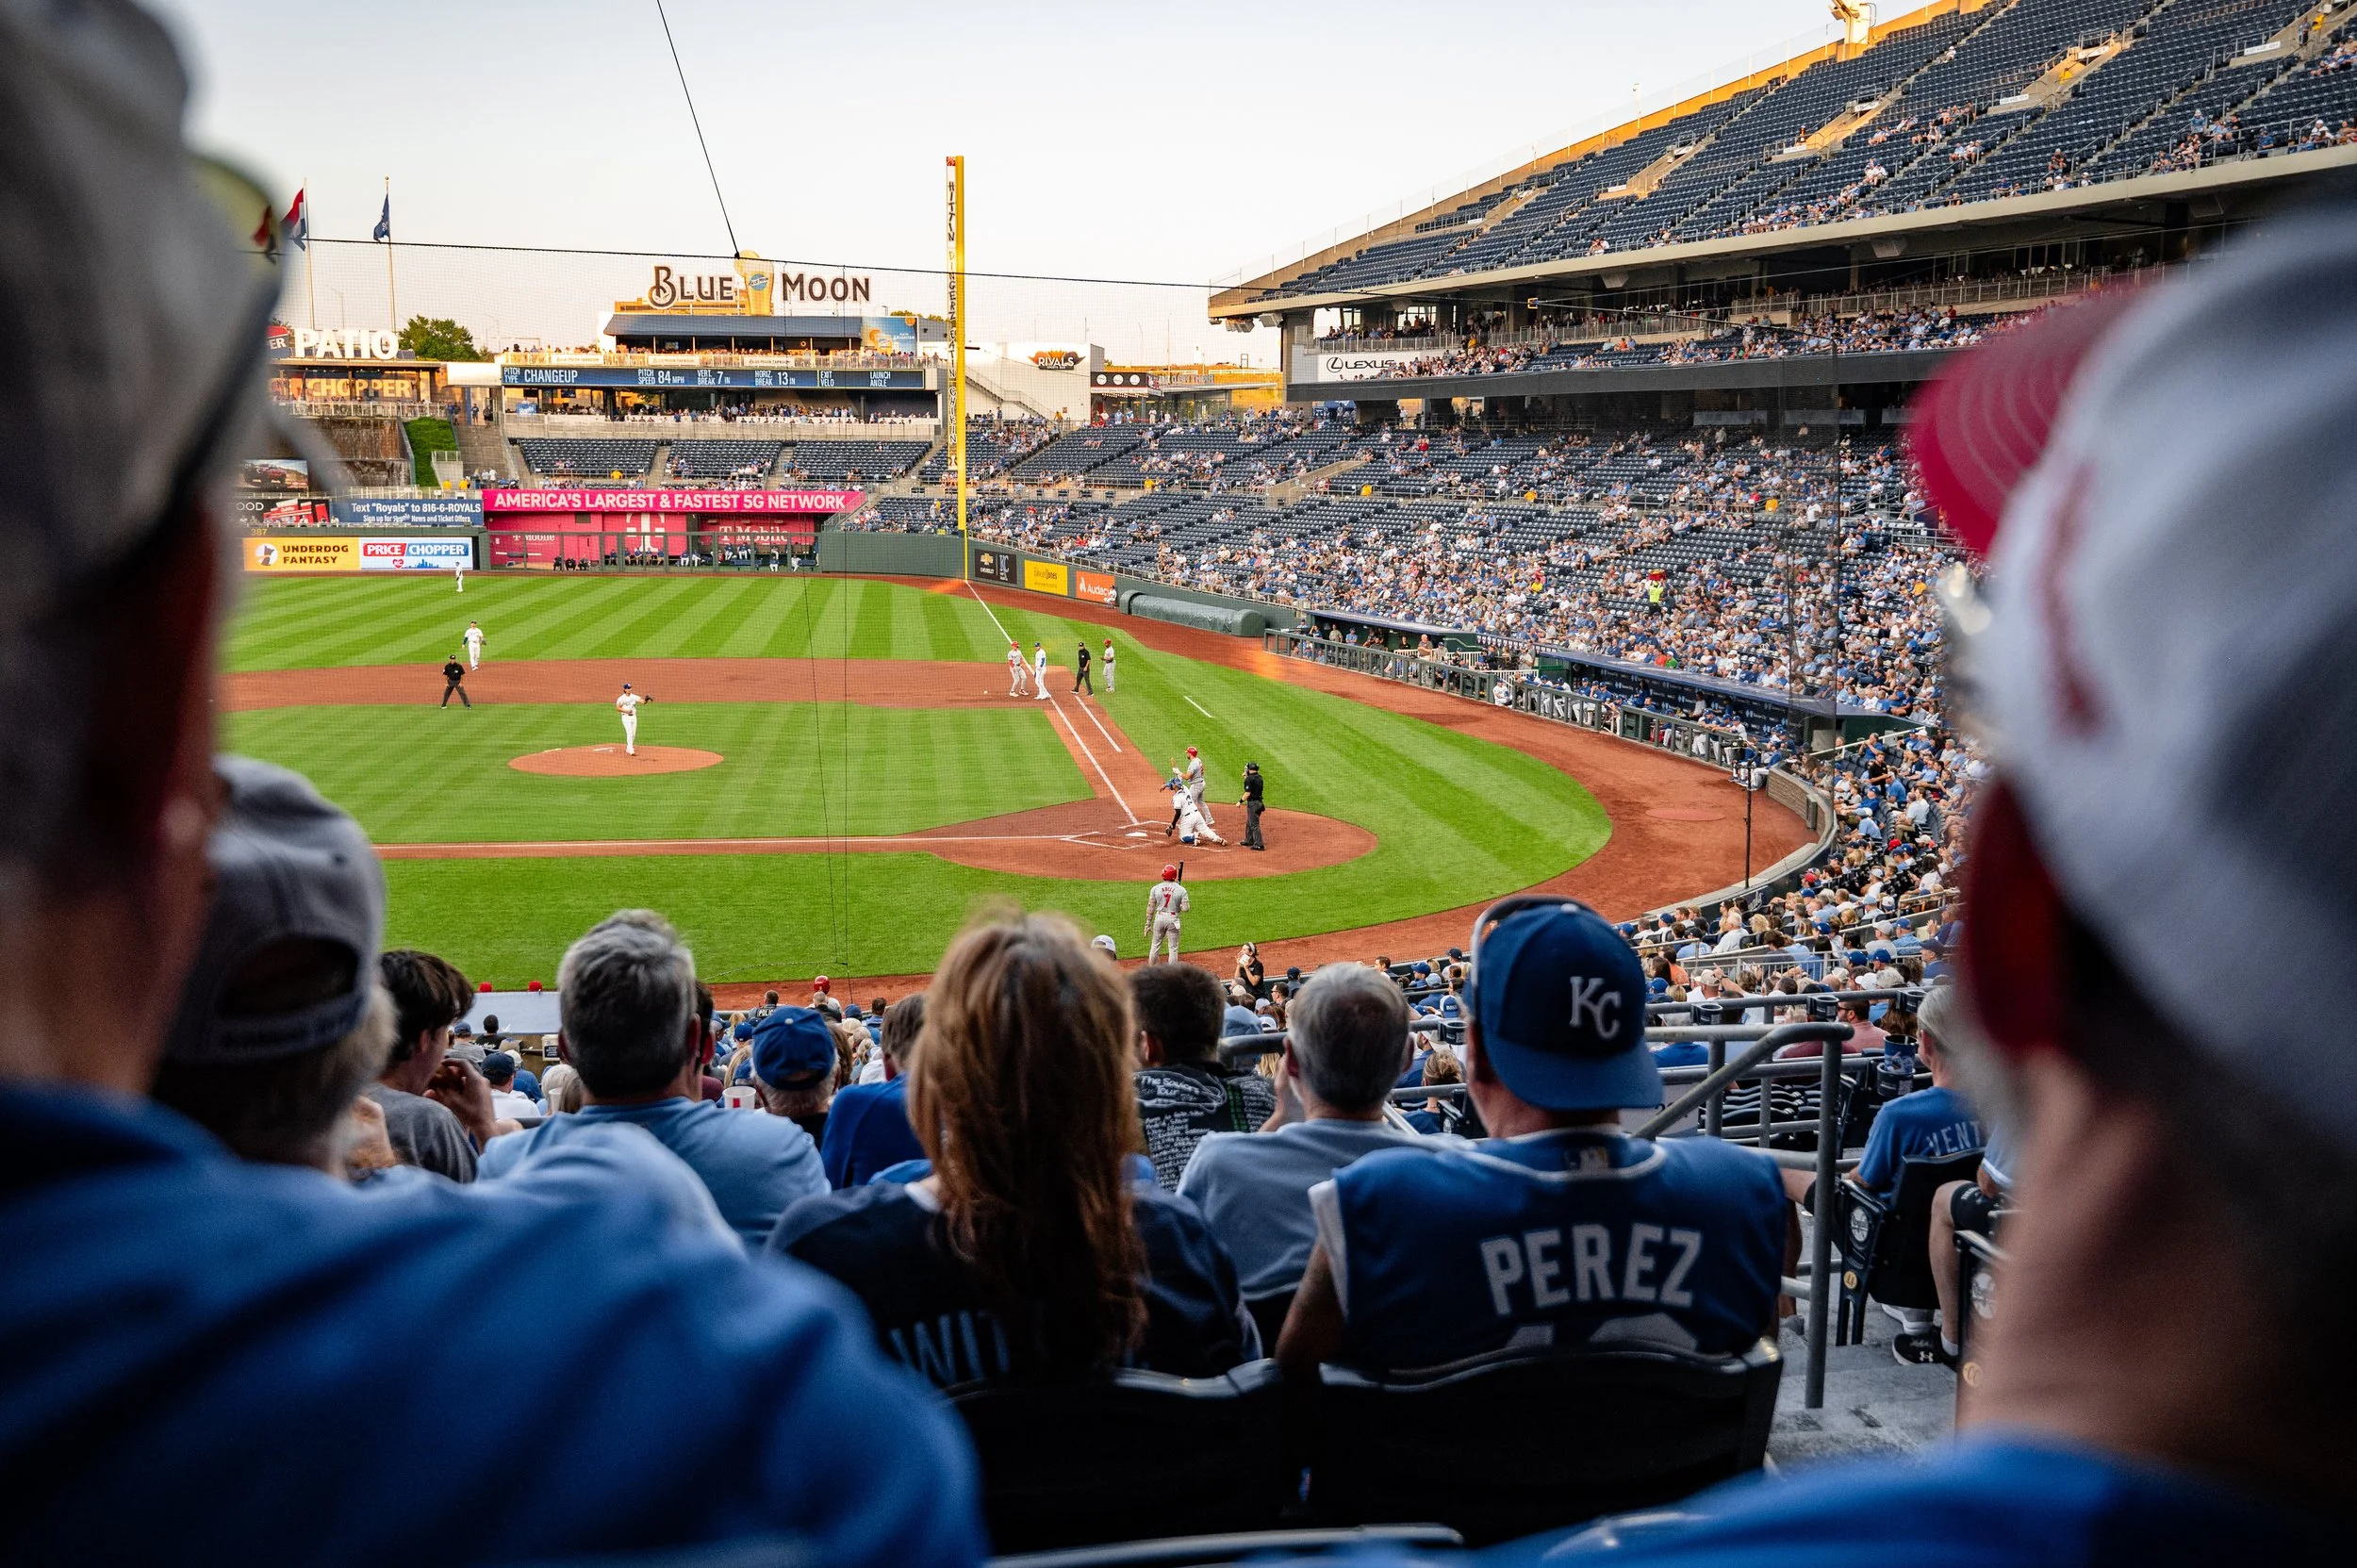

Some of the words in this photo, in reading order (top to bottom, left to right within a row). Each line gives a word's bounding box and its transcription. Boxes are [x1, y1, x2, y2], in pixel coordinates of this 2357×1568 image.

[948, 181, 956, 242] HITTIN
[648, 265, 733, 309] BLUE
[782, 272, 870, 302] MOON
[293, 329, 399, 360] PATIO
[1038, 356, 1075, 367] RIVALS
[503, 367, 520, 375] PITCH
[524, 370, 578, 383] CHANGEUP
[637, 369, 654, 377] PITCH
[869, 371, 891, 379] LAUNCH
[504, 375, 519, 384] TYPE
[637, 376, 656, 386] SPEED
[657, 371, 671, 384] 84
[697, 377, 716, 386] BREAK
[717, 371, 724, 385] 7
[724, 376, 731, 385] IN
[755, 377, 773, 386] BREAK
[777, 371, 789, 385] 13
[789, 377, 796, 386] IN
[305, 378, 412, 398] CHOPPER
[869, 379, 887, 388] ANGLE
[236, 502, 265, 511] OOD
[494, 493, 582, 508] AMERICA'S
[585, 493, 656, 508] LARGEST
[659, 494, 671, 508] &
[674, 493, 740, 508] FASTEST
[743, 494, 765, 509] 5G
[767, 494, 847, 509] NETWORK
[351, 503, 371, 513] Text
[371, 503, 409, 515] "Royals"
[411, 503, 420, 513] to
[421, 503, 482, 513] 816-6-ROYALS
[363, 515, 376, 523] Sign
[250, 528, 268, 536] 387
[282, 545, 349, 553] UNDERDOG
[367, 544, 402, 555] PRICE
[408, 544, 466, 555] CHOPPER
[283, 555, 338, 564] FANTASY
[1163, 893, 1172, 908] 7
[1569, 975, 1622, 1039] KC
[757, 1009, 774, 1017] POLIC
[1141, 1075, 1162, 1086] The
[1156, 1084, 1180, 1096] Tour
[1480, 1223, 1703, 1316] PEREZ
